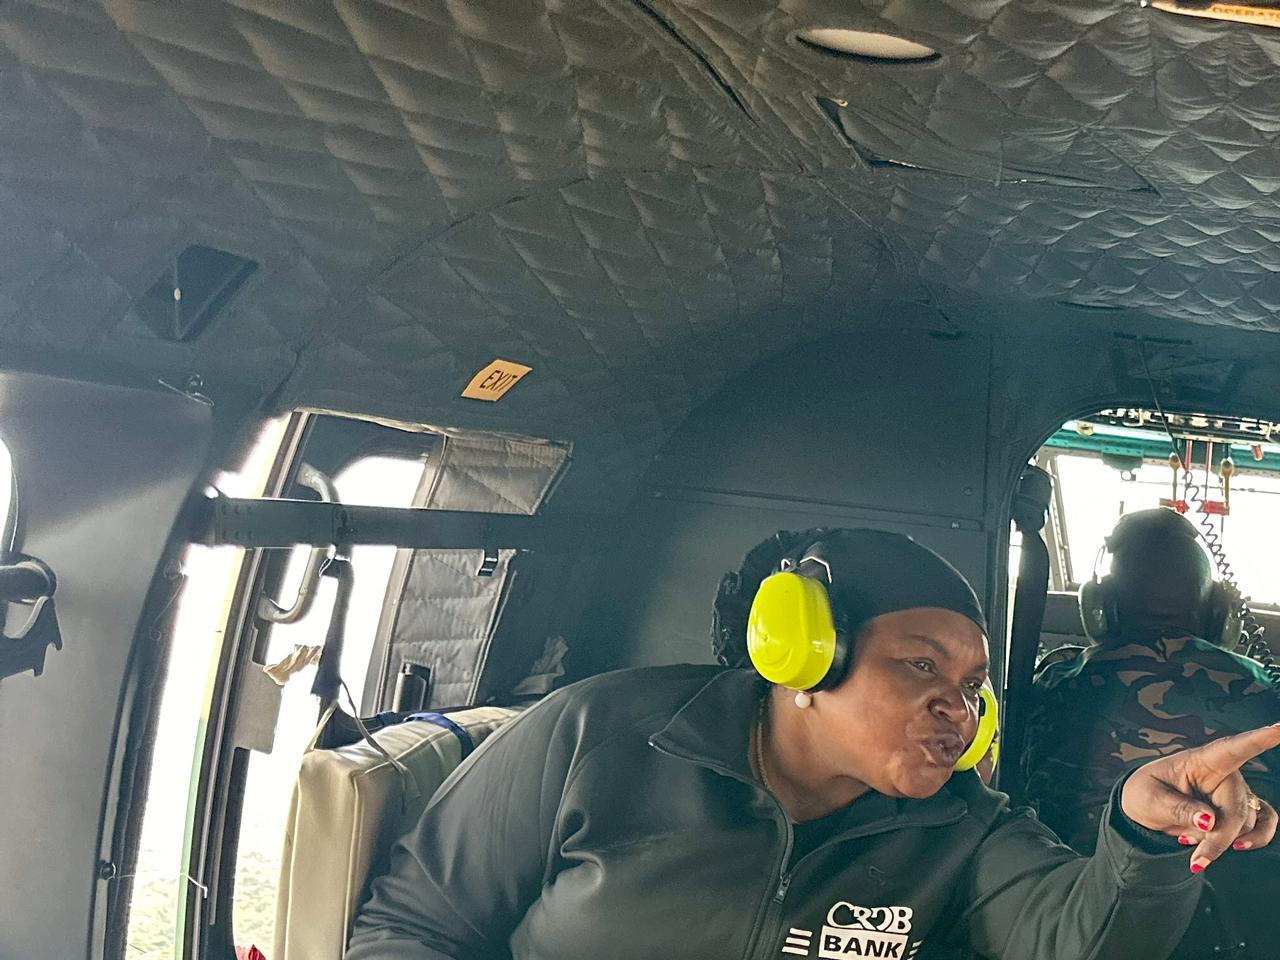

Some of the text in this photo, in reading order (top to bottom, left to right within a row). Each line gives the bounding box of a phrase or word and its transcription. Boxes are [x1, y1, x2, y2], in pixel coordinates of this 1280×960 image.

[480, 369, 518, 391] EXIT
[826, 901, 913, 934] CRDB
[823, 934, 903, 958] BANK
